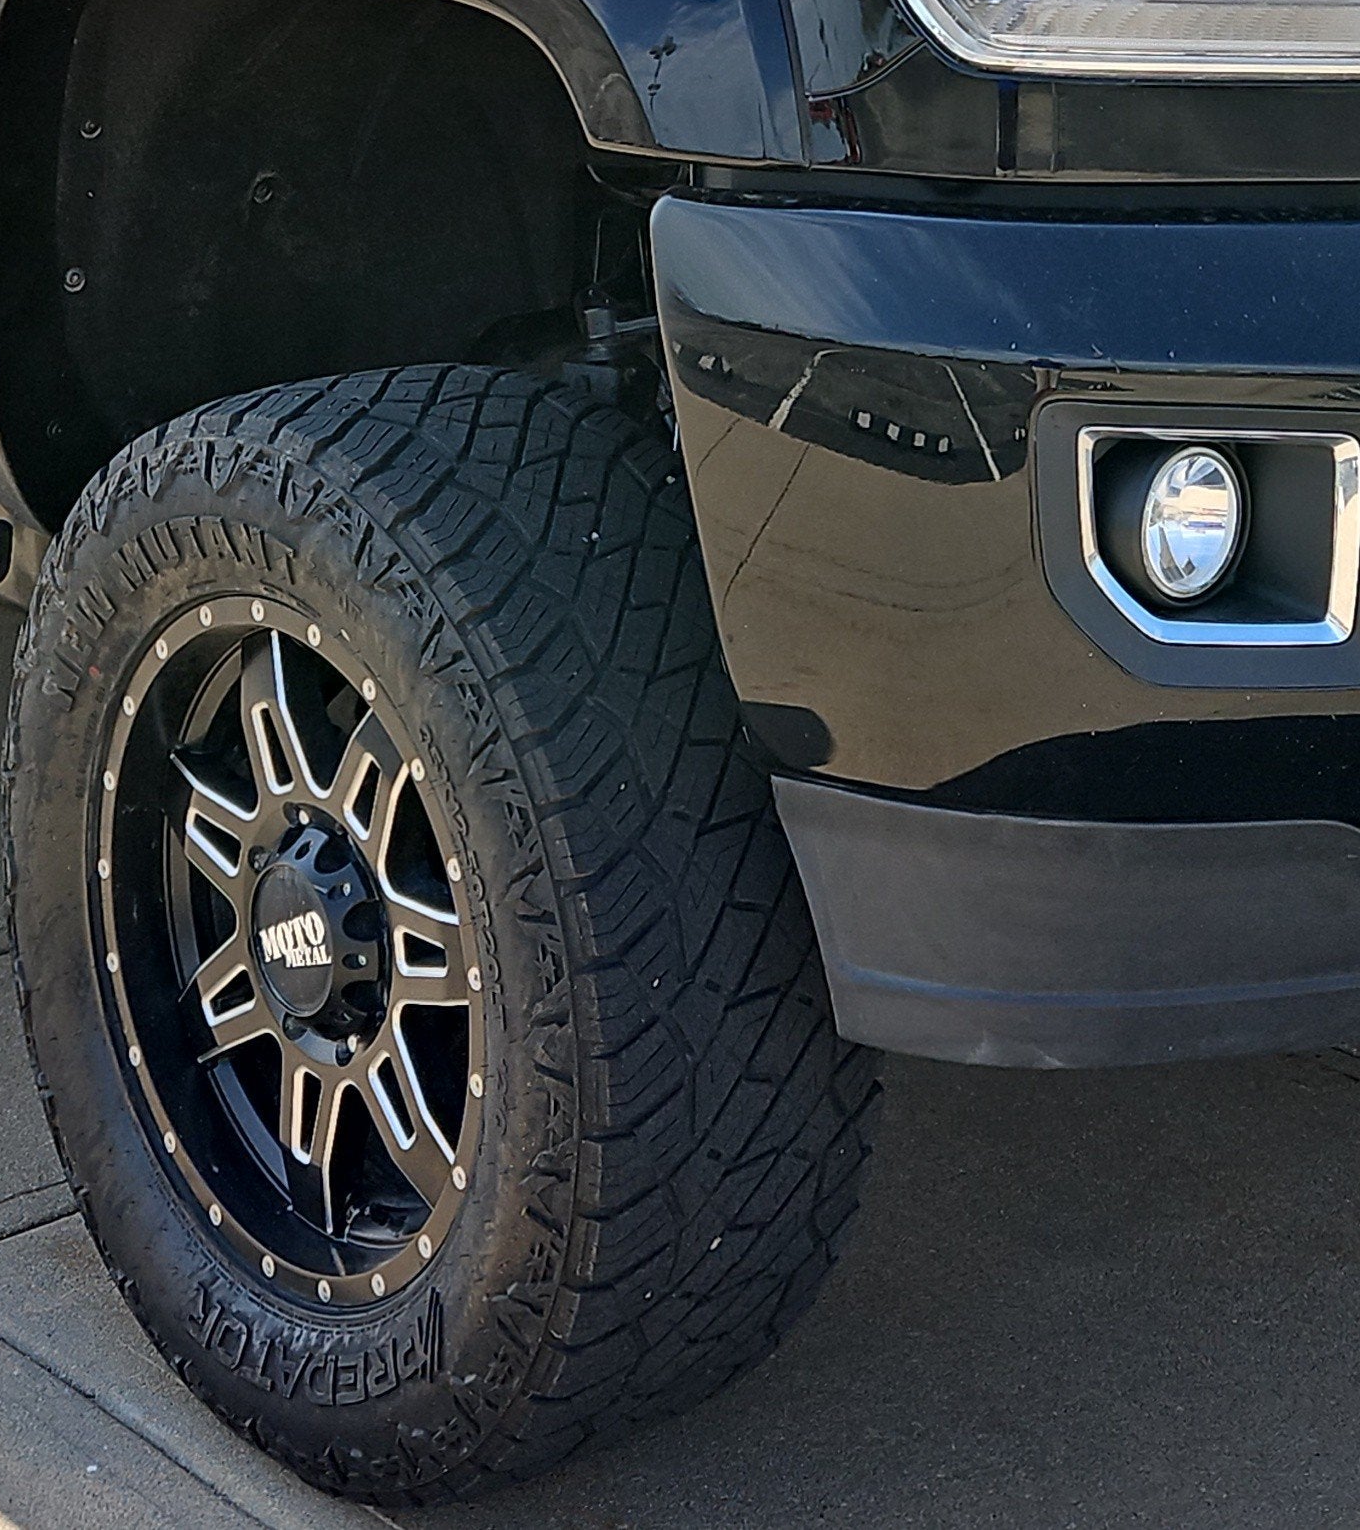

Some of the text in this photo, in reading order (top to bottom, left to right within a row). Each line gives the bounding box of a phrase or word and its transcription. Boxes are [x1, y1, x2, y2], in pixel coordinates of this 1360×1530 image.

[111, 515, 296, 592] MUTANT
[259, 911, 325, 963] MOTO
[285, 944, 332, 968] METAL
[188, 1282, 440, 1406] PREDATOR
